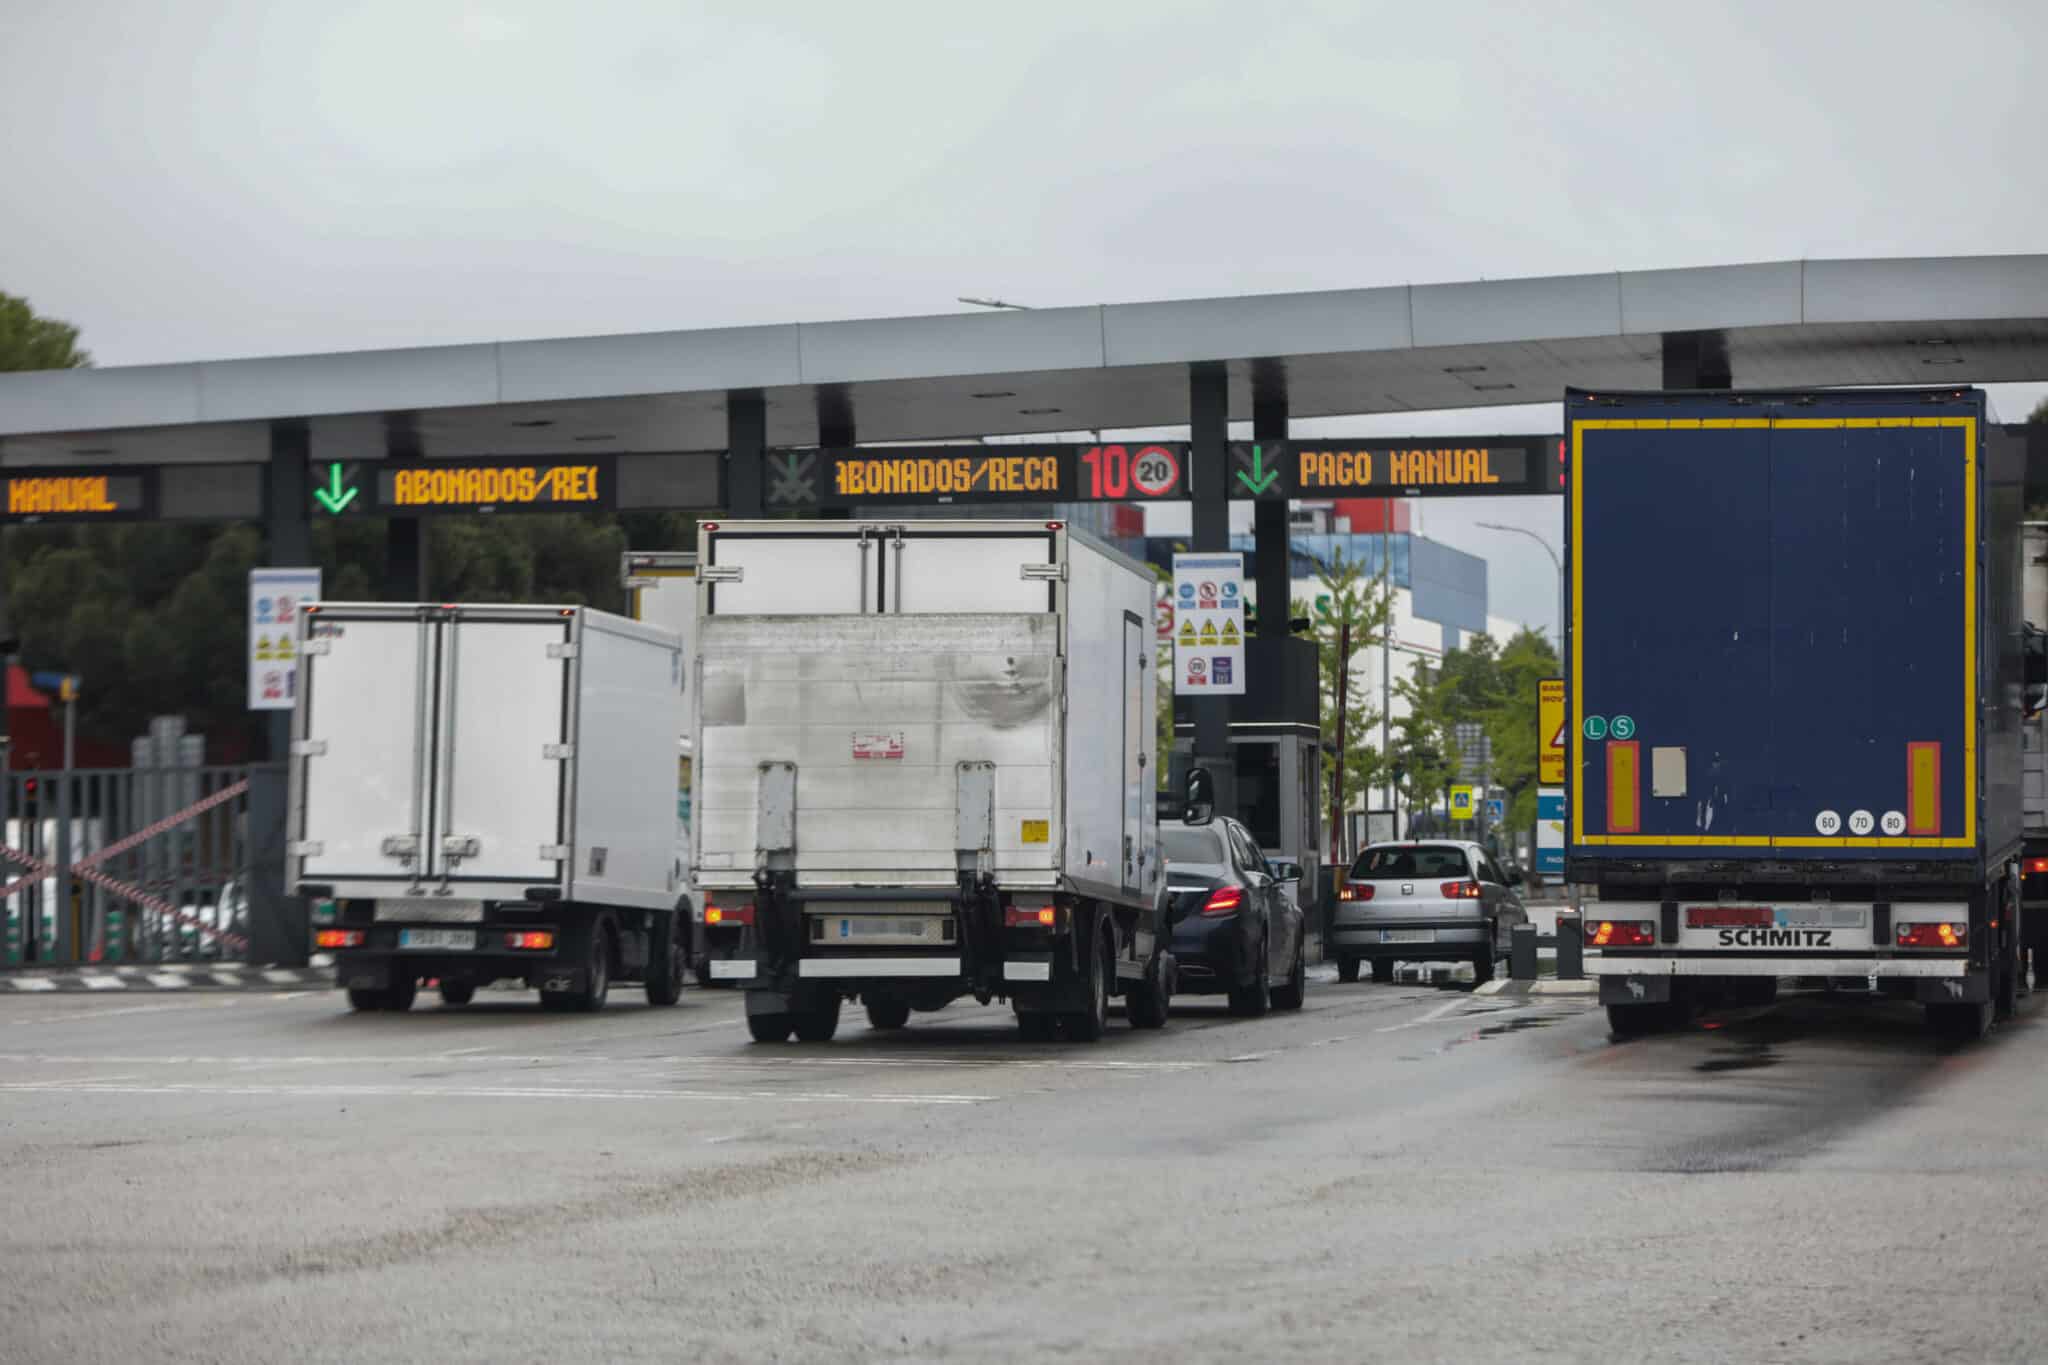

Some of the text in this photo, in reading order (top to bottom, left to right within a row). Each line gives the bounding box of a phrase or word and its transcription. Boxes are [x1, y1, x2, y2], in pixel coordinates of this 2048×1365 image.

[1082, 445, 1127, 498] 10
[1139, 461, 1169, 482] 20
[1300, 449, 1499, 486] PAGO MANUAL
[9, 475, 117, 512] MANUAL
[1590, 720, 1601, 735] L
[1616, 718, 1629, 736] S
[1822, 816, 1835, 829] 60
[1855, 816, 1868, 829] 70
[1887, 817, 1900, 829] 80
[1719, 929, 1832, 946] SCHMITZ
